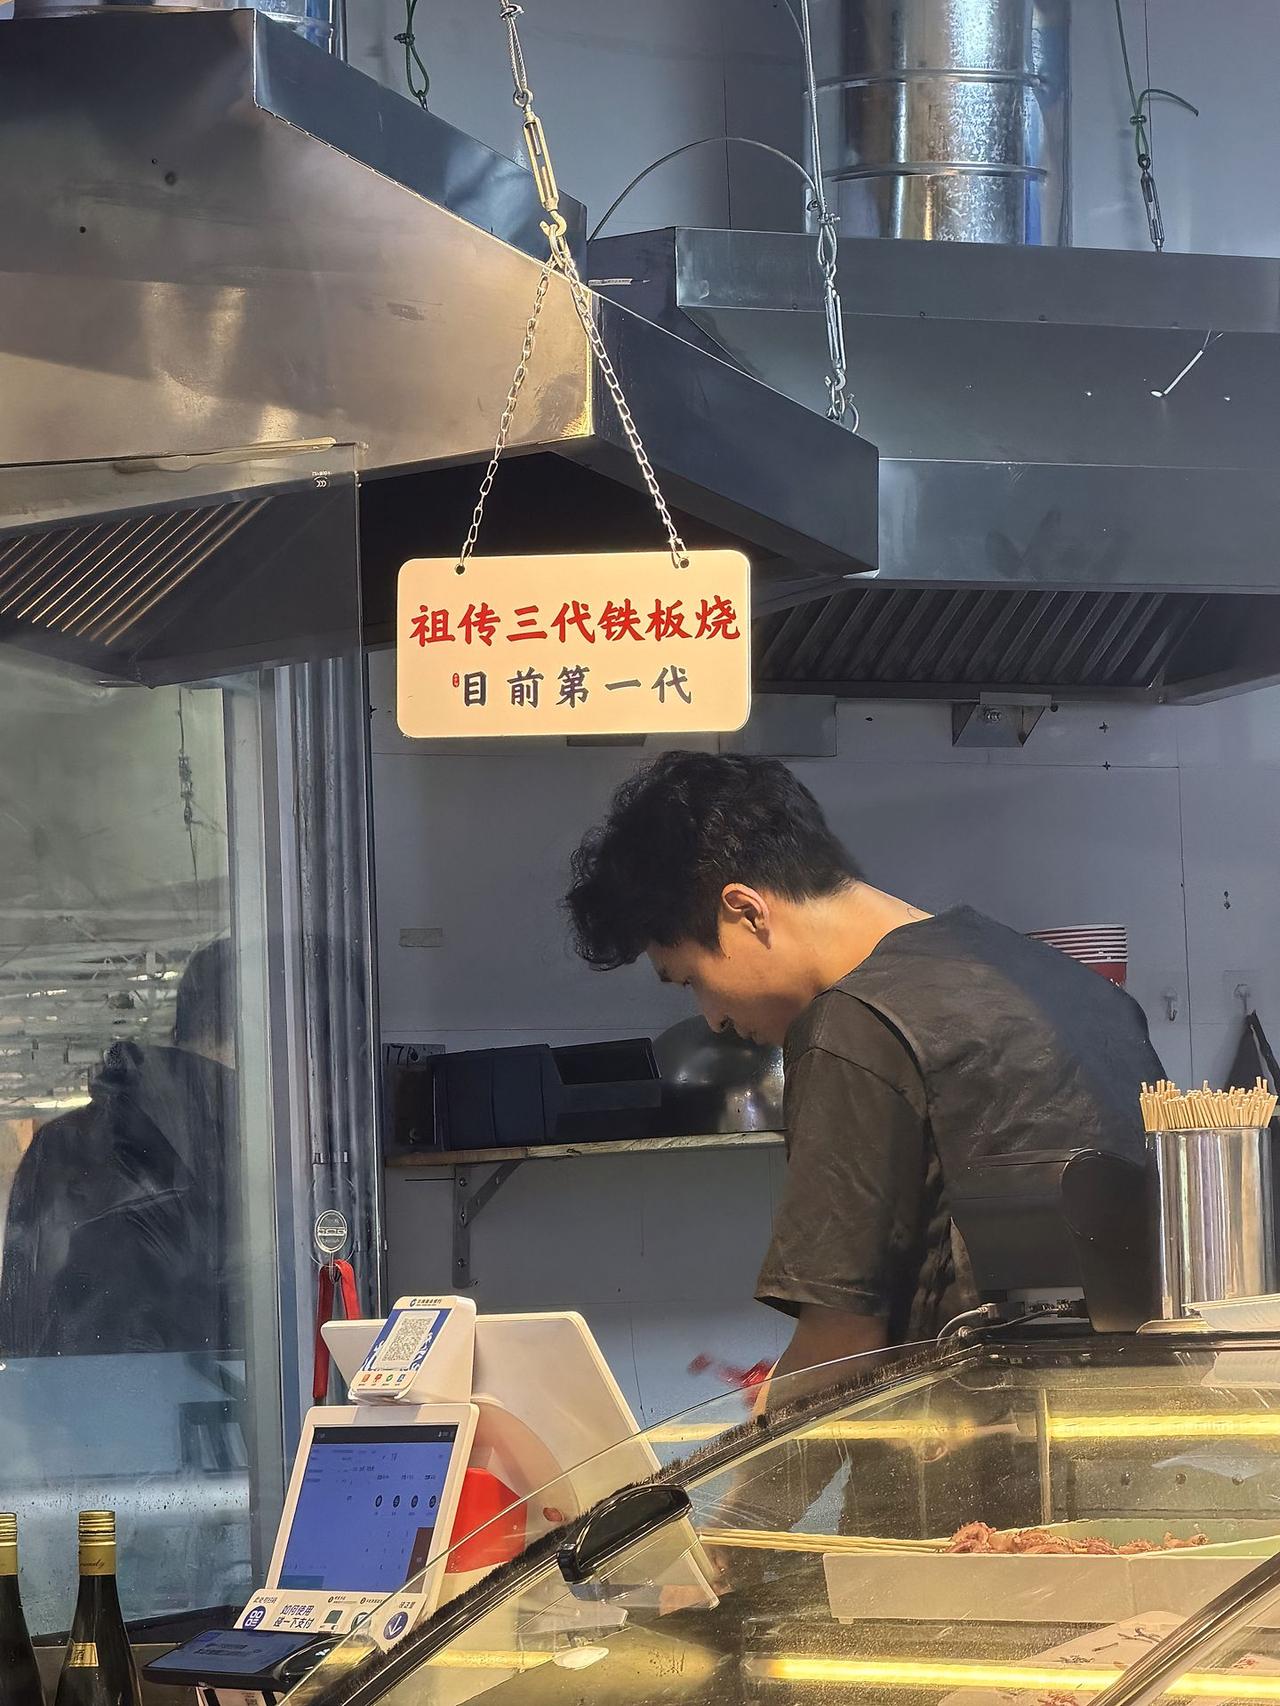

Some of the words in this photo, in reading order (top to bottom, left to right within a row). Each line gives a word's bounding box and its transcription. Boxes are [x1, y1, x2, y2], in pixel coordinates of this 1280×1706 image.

[409, 594, 741, 647] 祖传三代铁板烧
[463, 664, 692, 708] 目前第一代
[281, 1604, 315, 1616] 如何使用
